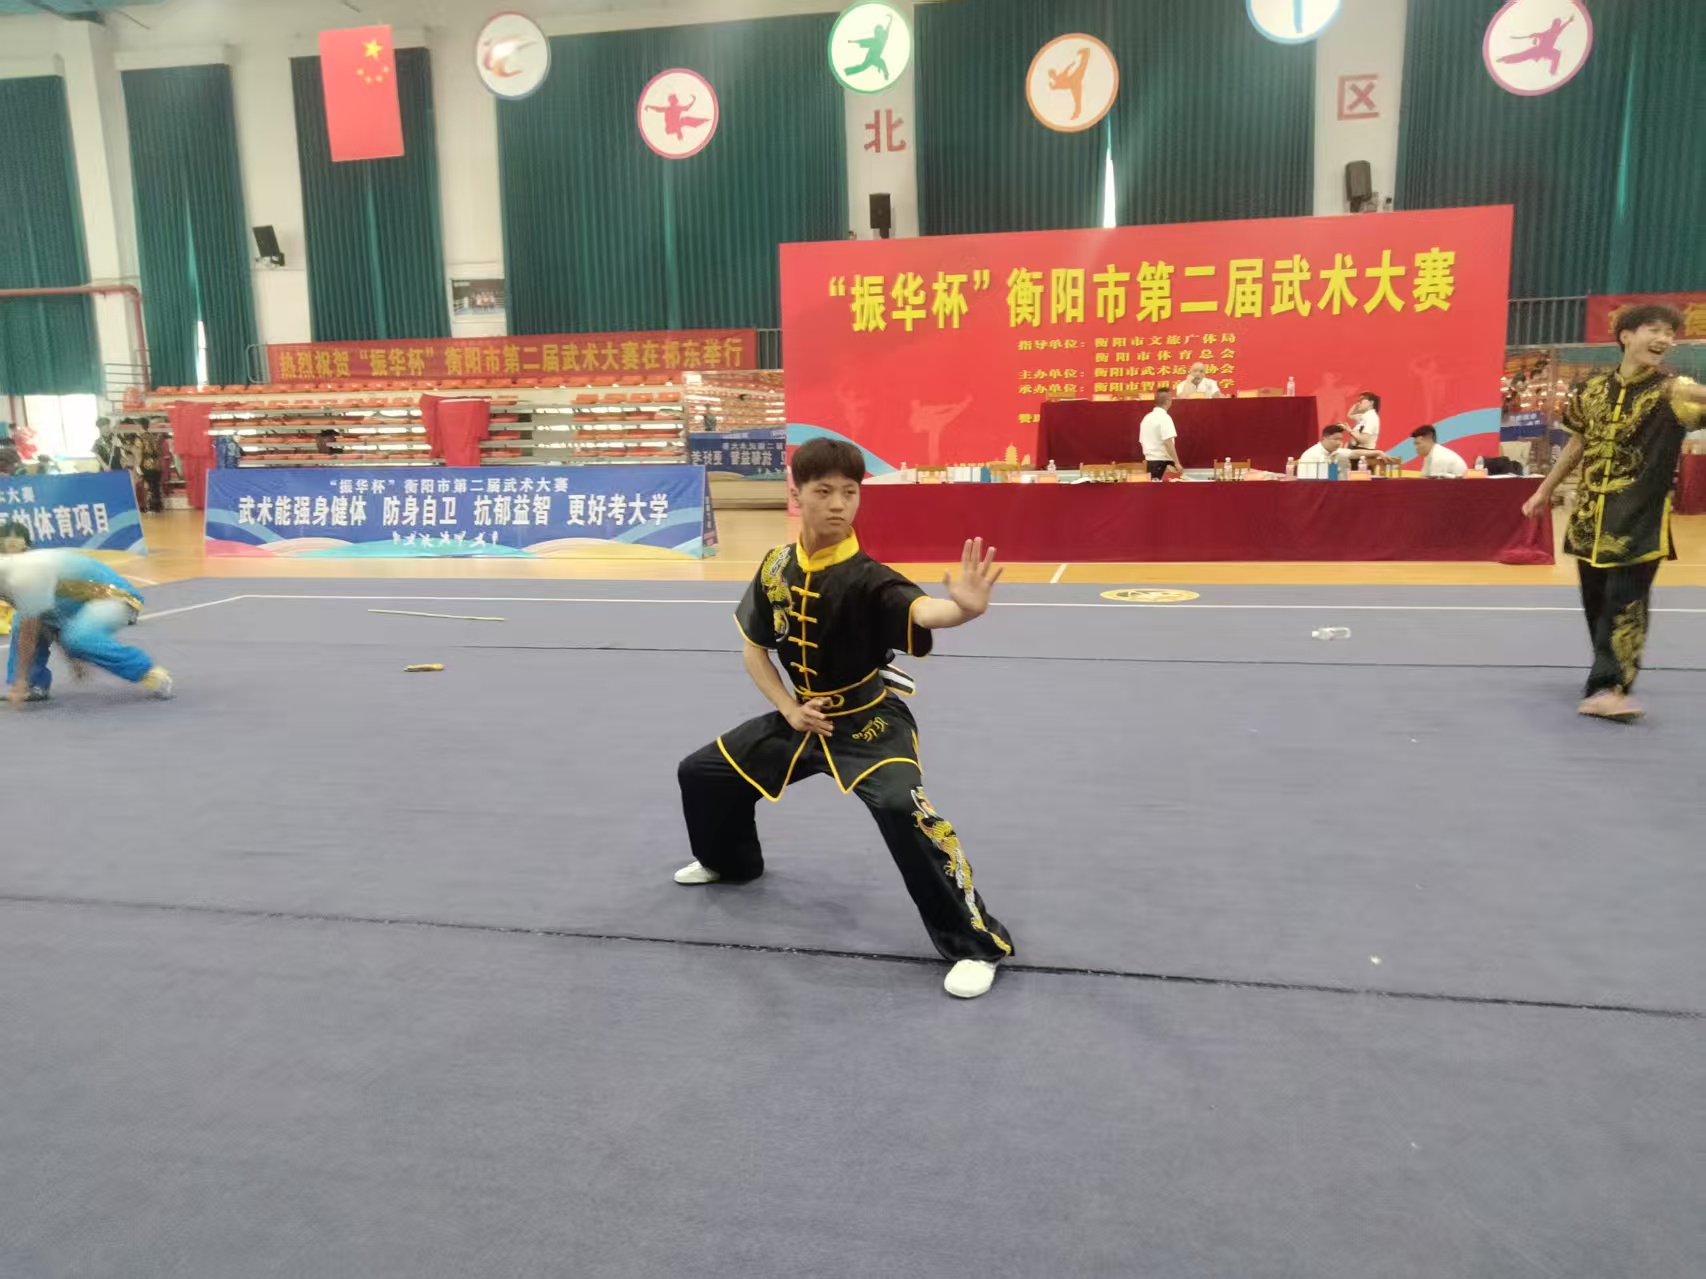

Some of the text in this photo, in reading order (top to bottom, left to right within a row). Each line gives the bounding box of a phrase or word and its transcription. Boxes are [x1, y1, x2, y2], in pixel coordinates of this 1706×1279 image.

[1337, 74, 1379, 120] 区
[864, 109, 906, 153] 北
[1094, 363, 1236, 378] 衡阳市武术运协会
[238, 496, 367, 526] 武术能强身健体
[383, 496, 457, 526] 防身自卫
[474, 494, 551, 526] 抗郁益智
[567, 493, 669, 526] 更好考大学
